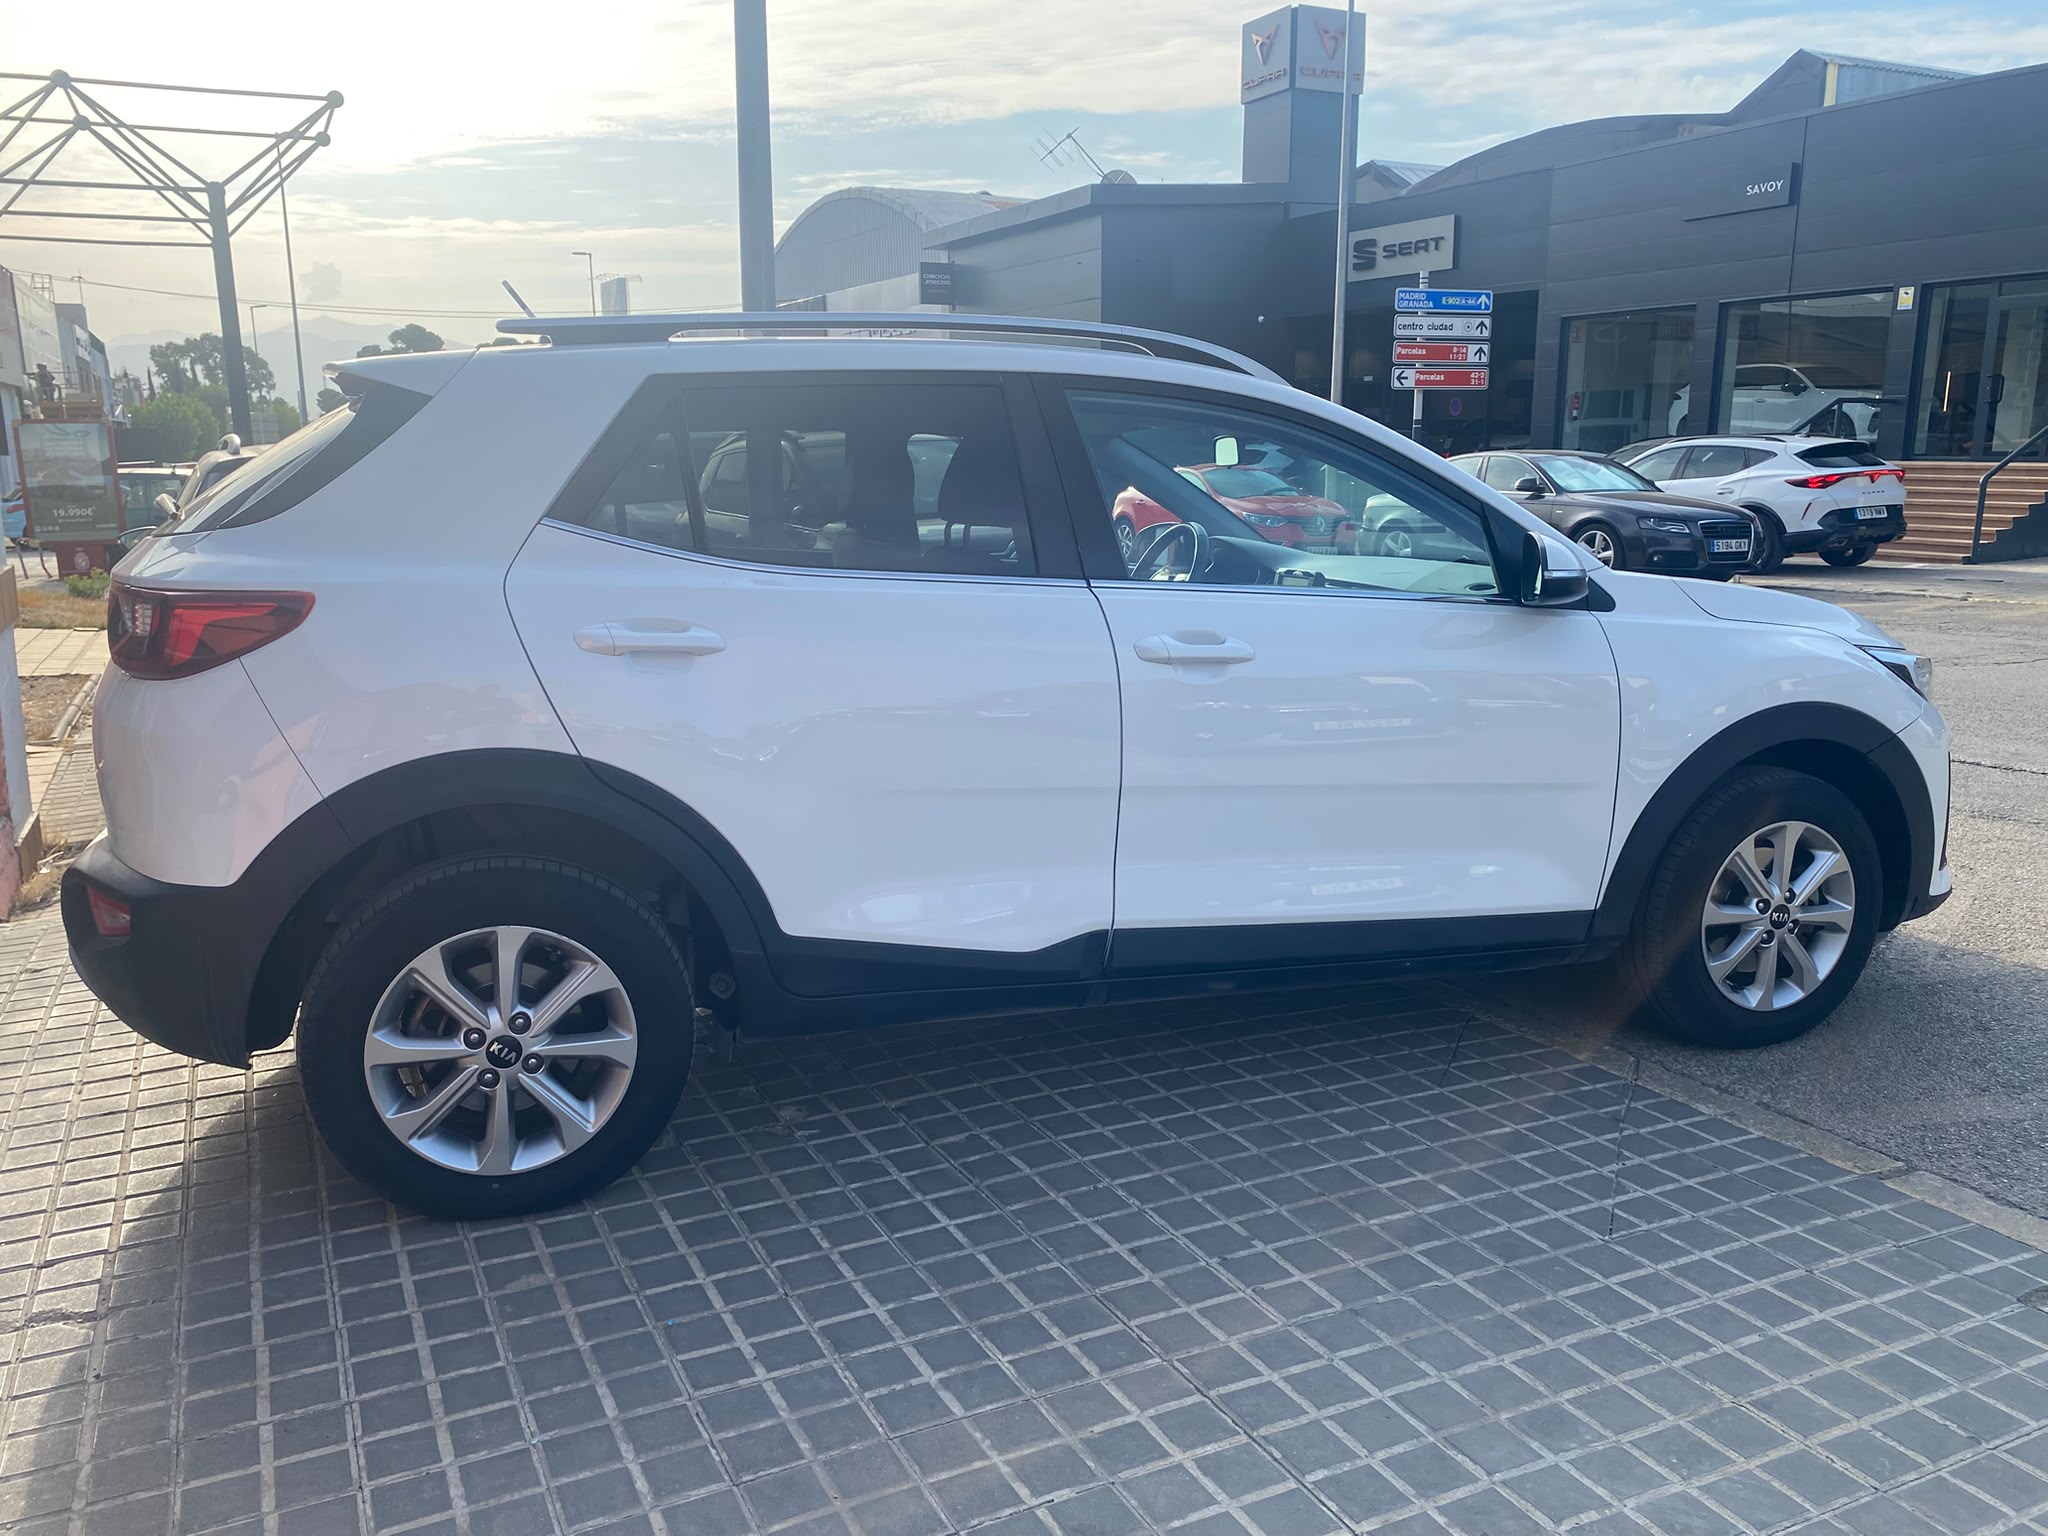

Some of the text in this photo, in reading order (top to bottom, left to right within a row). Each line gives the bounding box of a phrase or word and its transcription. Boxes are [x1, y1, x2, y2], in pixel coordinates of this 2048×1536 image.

[1746, 179, 1784, 196] SAVOY
[1382, 236, 1445, 259] SEAT
[1399, 292, 1426, 300] MADRID
[1398, 300, 1434, 308] GRANADA
[1397, 321, 1454, 331] centro ciudad
[1396, 346, 1427, 355] Parcelas
[1415, 373, 1445, 381] Parcelas
[1771, 912, 1788, 922] KIA
[489, 1041, 517, 1064] KIA
